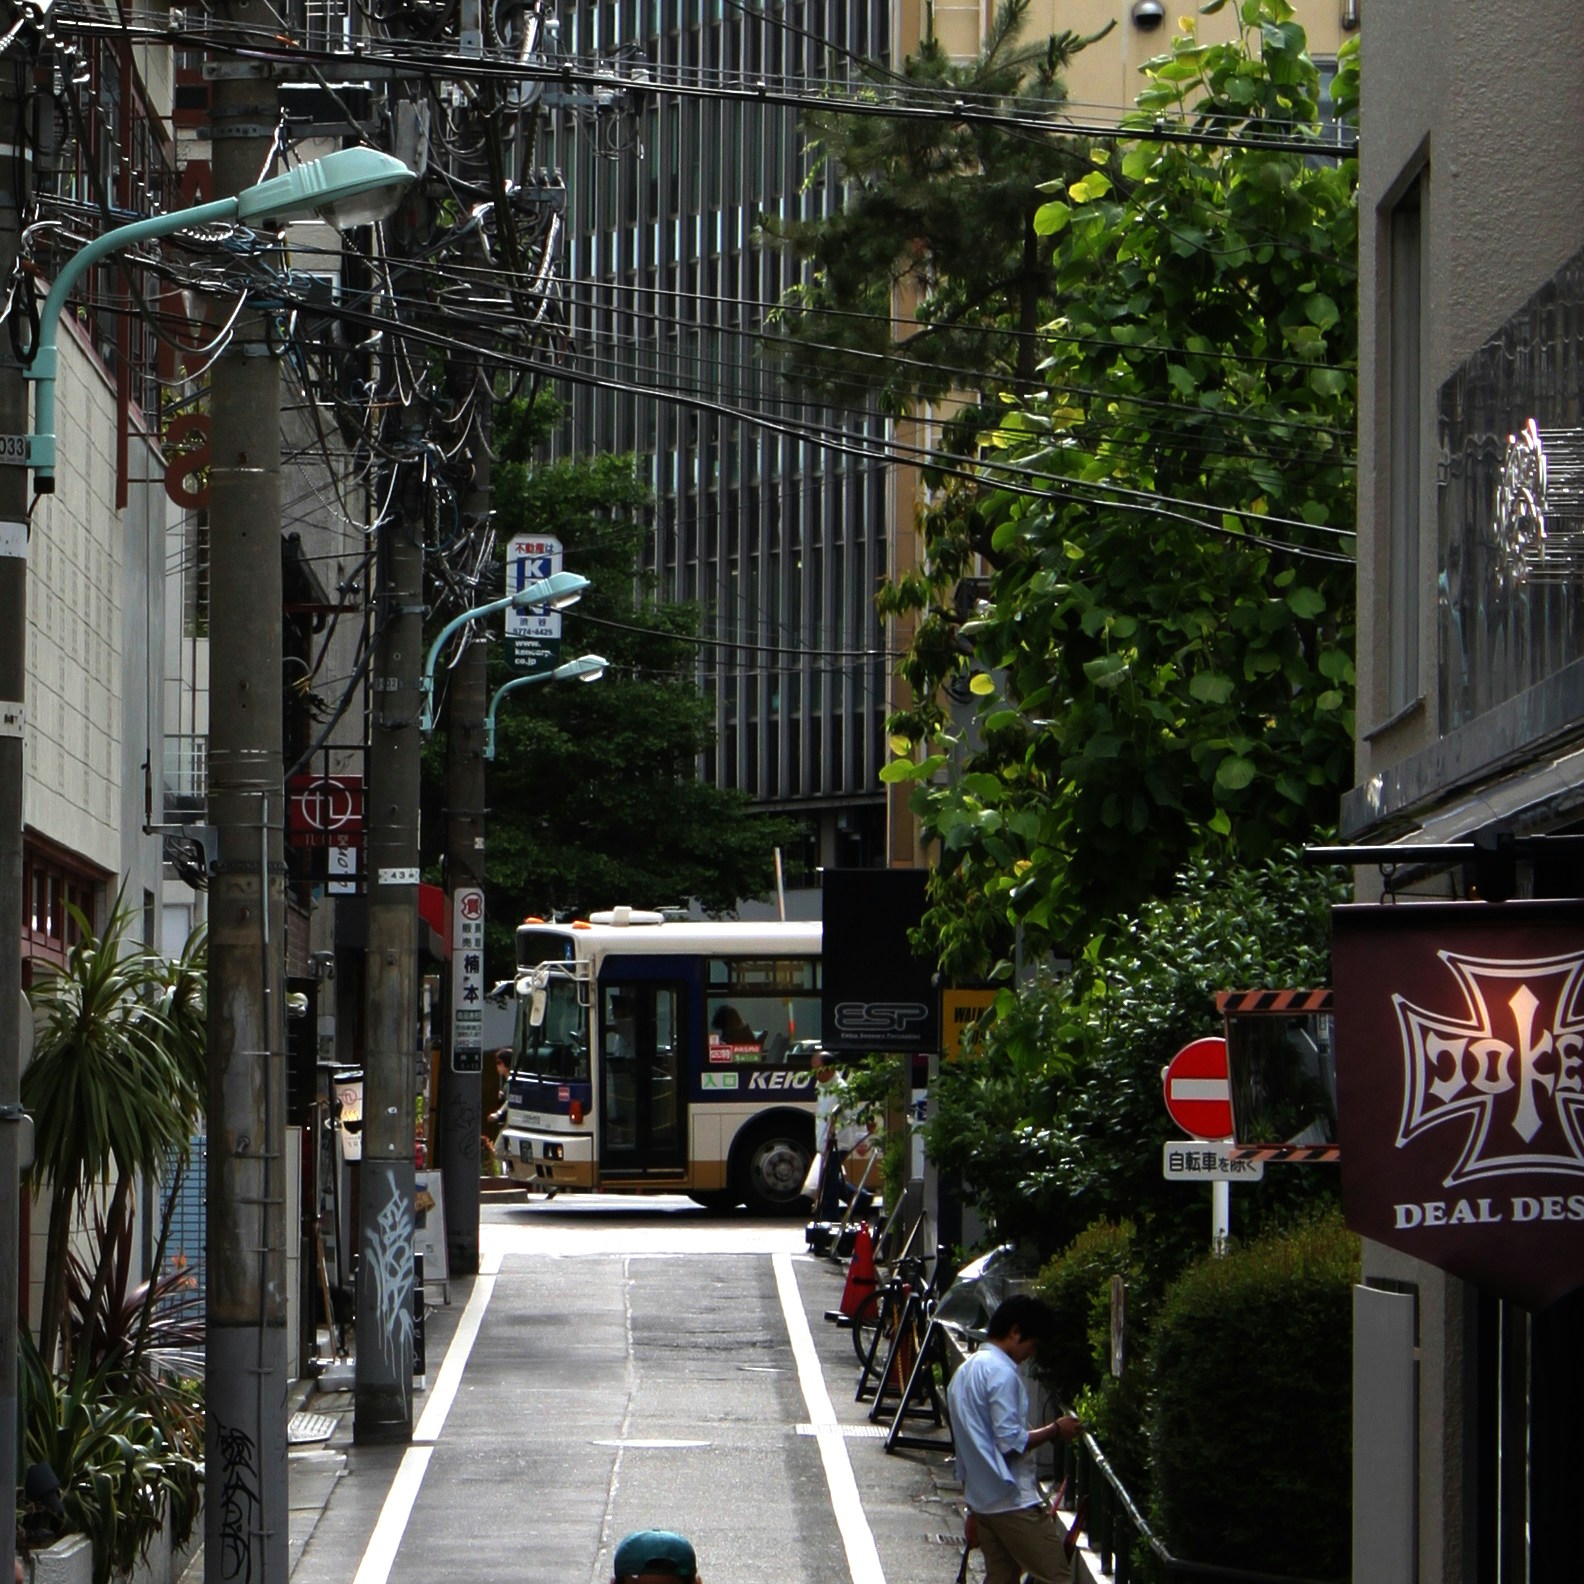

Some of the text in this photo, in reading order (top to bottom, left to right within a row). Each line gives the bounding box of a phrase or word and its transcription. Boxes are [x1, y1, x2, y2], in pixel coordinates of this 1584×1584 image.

[515, 542, 555, 555] 不動産は
[834, 1001, 929, 1031] ESP
[748, 1071, 812, 1090] KEIO
[1168, 1150, 1257, 1173] 自転車を除く
[1394, 1198, 1502, 1229] DEAL
